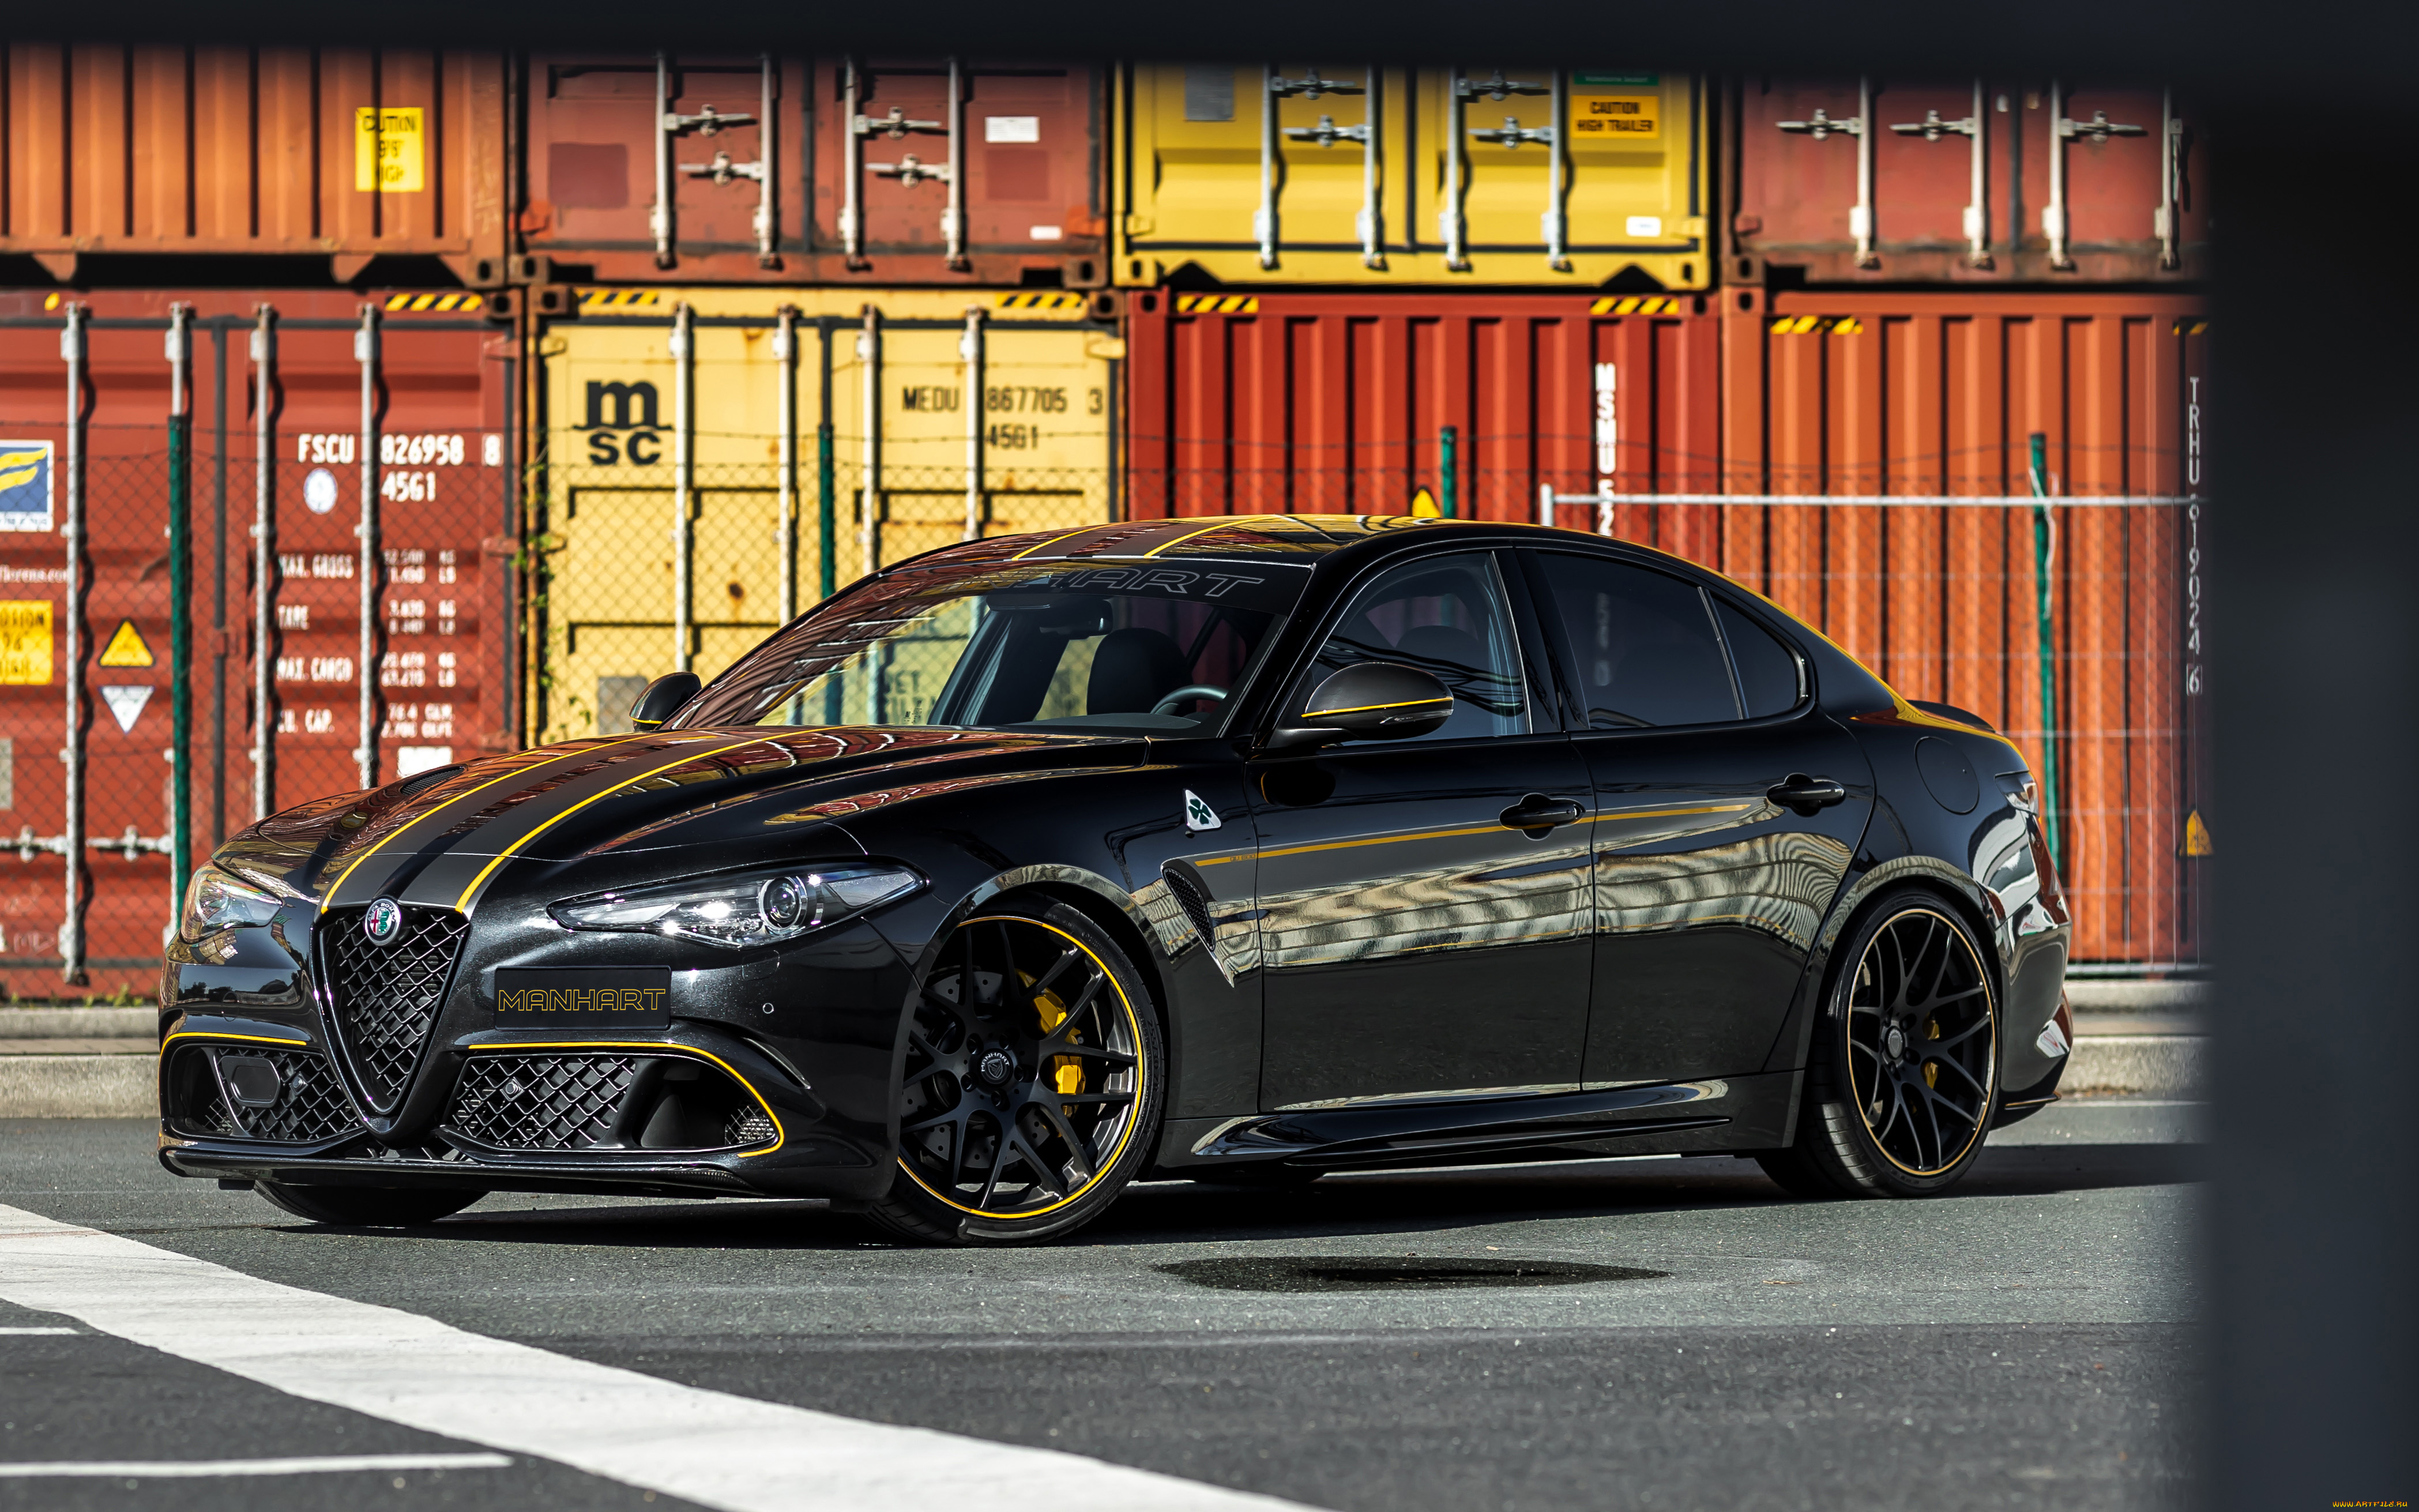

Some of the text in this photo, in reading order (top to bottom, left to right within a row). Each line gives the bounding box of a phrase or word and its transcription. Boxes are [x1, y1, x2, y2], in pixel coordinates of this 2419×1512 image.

[902, 385, 1103, 416] MEDU 867705 3
[2189, 377, 2200, 485] TRHU
[298, 433, 501, 466] FSCU 826958 8
[381, 471, 437, 502] 45G1
[499, 988, 666, 1011] MANHART
[981, 1052, 1010, 1072] MANHART
